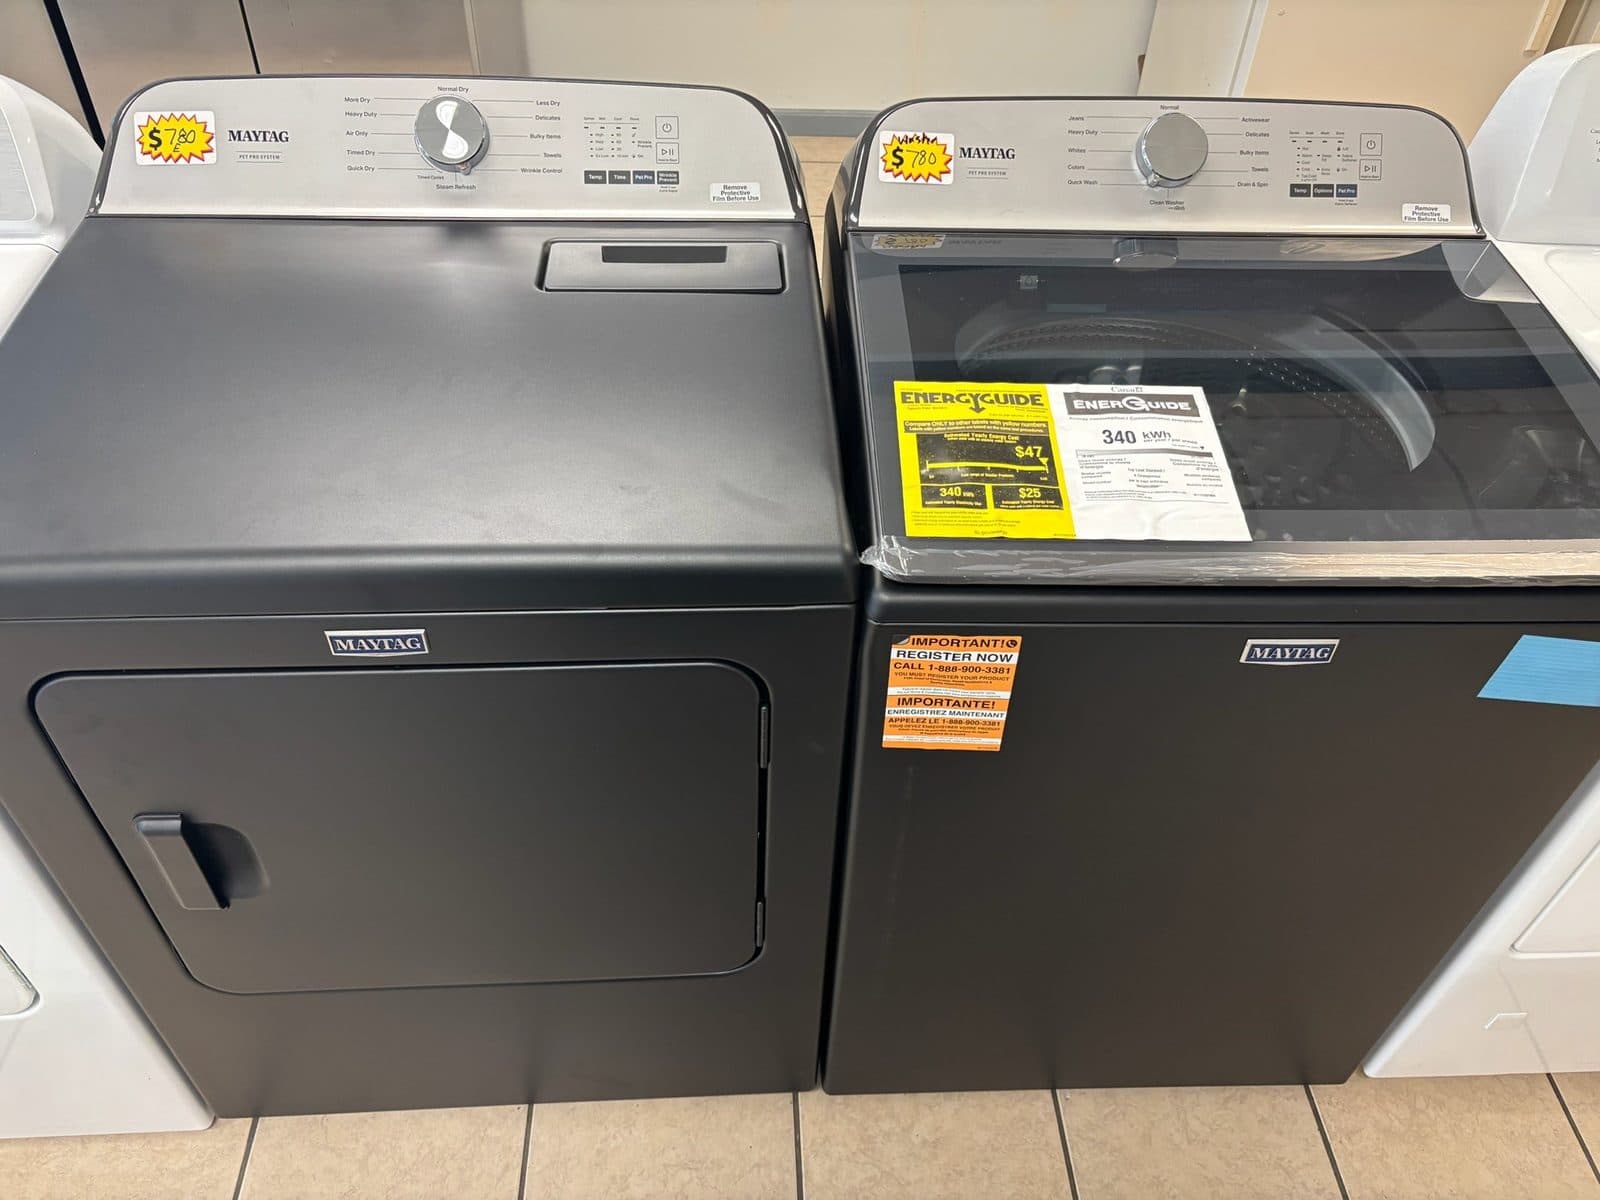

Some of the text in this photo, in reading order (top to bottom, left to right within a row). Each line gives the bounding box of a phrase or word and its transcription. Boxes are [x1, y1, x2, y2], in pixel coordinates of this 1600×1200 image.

[458, 86, 469, 94] Dry
[228, 129, 290, 143] MAYTAG
[354, 130, 368, 138] Only
[363, 149, 375, 157] Dry
[959, 147, 1017, 160] MAYTAG
[364, 165, 375, 173] Dry
[901, 391, 1045, 408] ENERGYGUIDE
[1072, 395, 1192, 412] ENERGUIDE
[989, 433, 1007, 441] Energy
[1102, 429, 1172, 445] 340 kWh
[1014, 445, 1042, 459] $47
[939, 486, 962, 497] 340
[1018, 487, 1042, 499] $25
[334, 637, 422, 651] MAYTAG
[911, 637, 1006, 649] IMPORTANT!
[896, 650, 1014, 663] REGISTER NOW
[1250, 647, 1331, 659] MAYTAG
[893, 661, 1011, 675] CALL 1-888-900-3381
[927, 672, 960, 680] REGISTER
[897, 697, 996, 710] IMPORTANTE!
[887, 708, 1006, 719] ENREGISTREZ MAINTENANT
[888, 717, 928, 725] APPELEZ
[942, 718, 1001, 727] 1-888-900-3381
